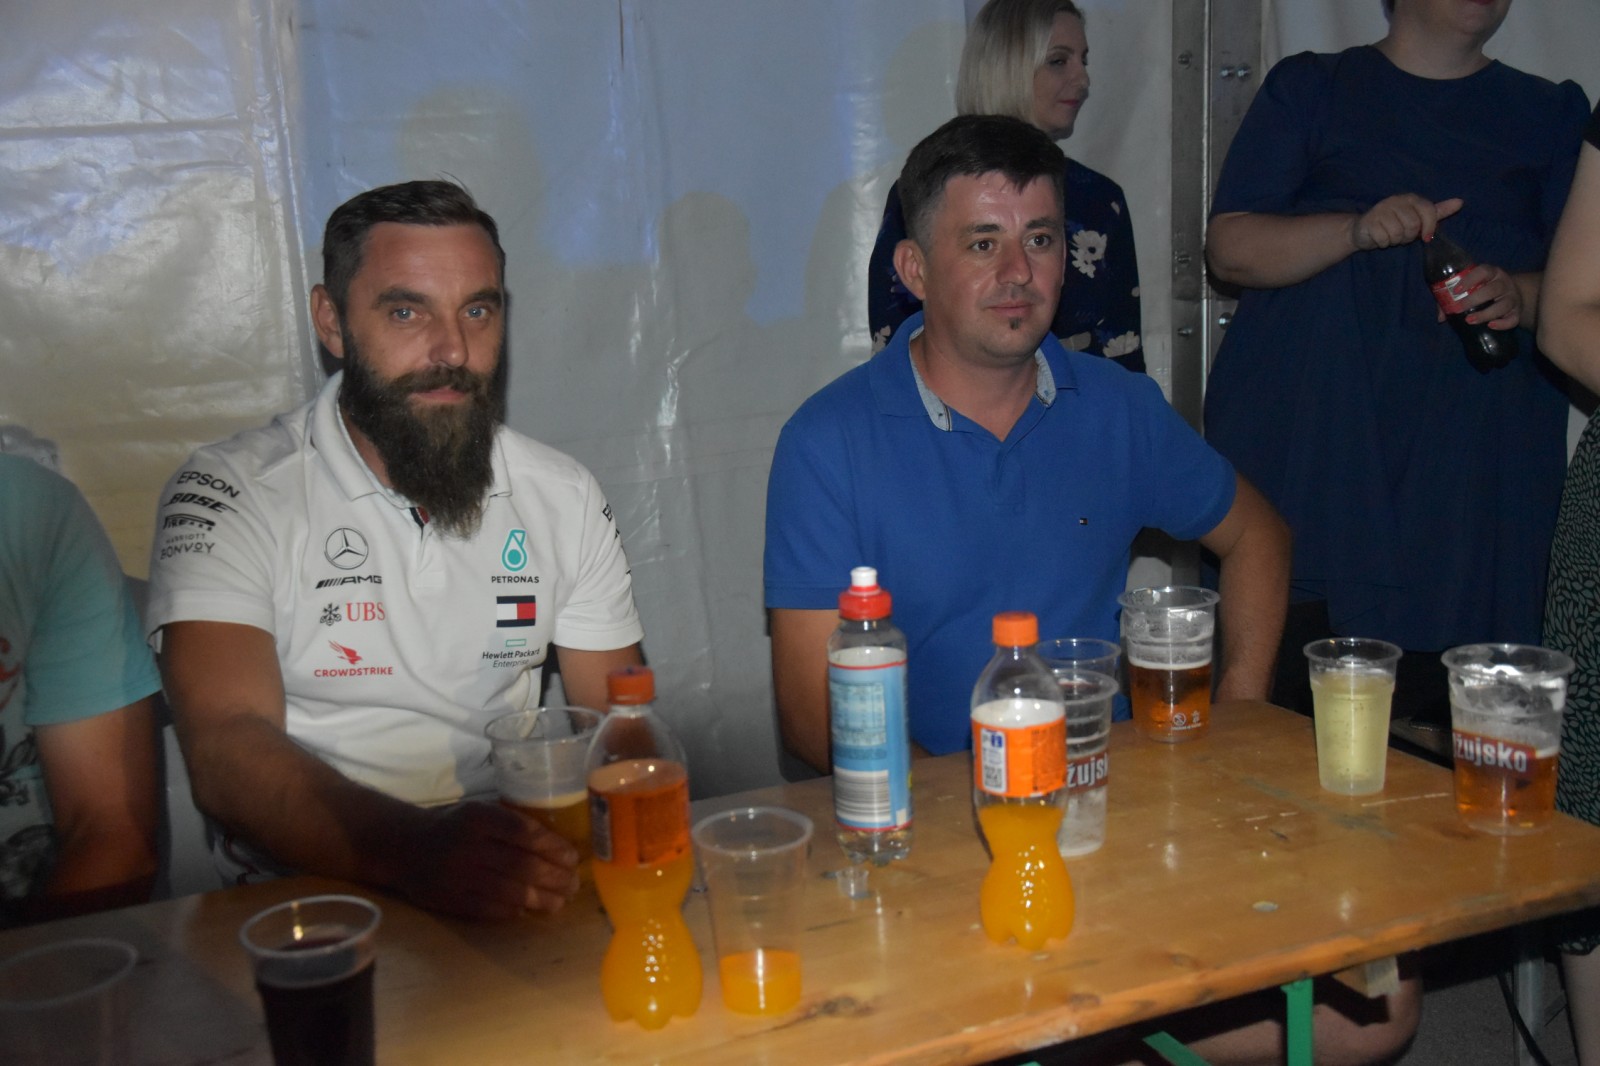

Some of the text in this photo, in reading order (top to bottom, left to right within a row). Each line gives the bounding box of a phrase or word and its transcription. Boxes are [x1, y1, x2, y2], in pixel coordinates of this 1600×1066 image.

[177, 471, 240, 498] EPSON
[164, 493, 238, 513] BOSE
[491, 576, 540, 584] PETRONAS
[345, 602, 386, 622] UBS
[482, 651, 514, 659] Hewlett
[314, 666, 393, 678] CROWDSTRIKE
[1453, 732, 1528, 772] žujsko
